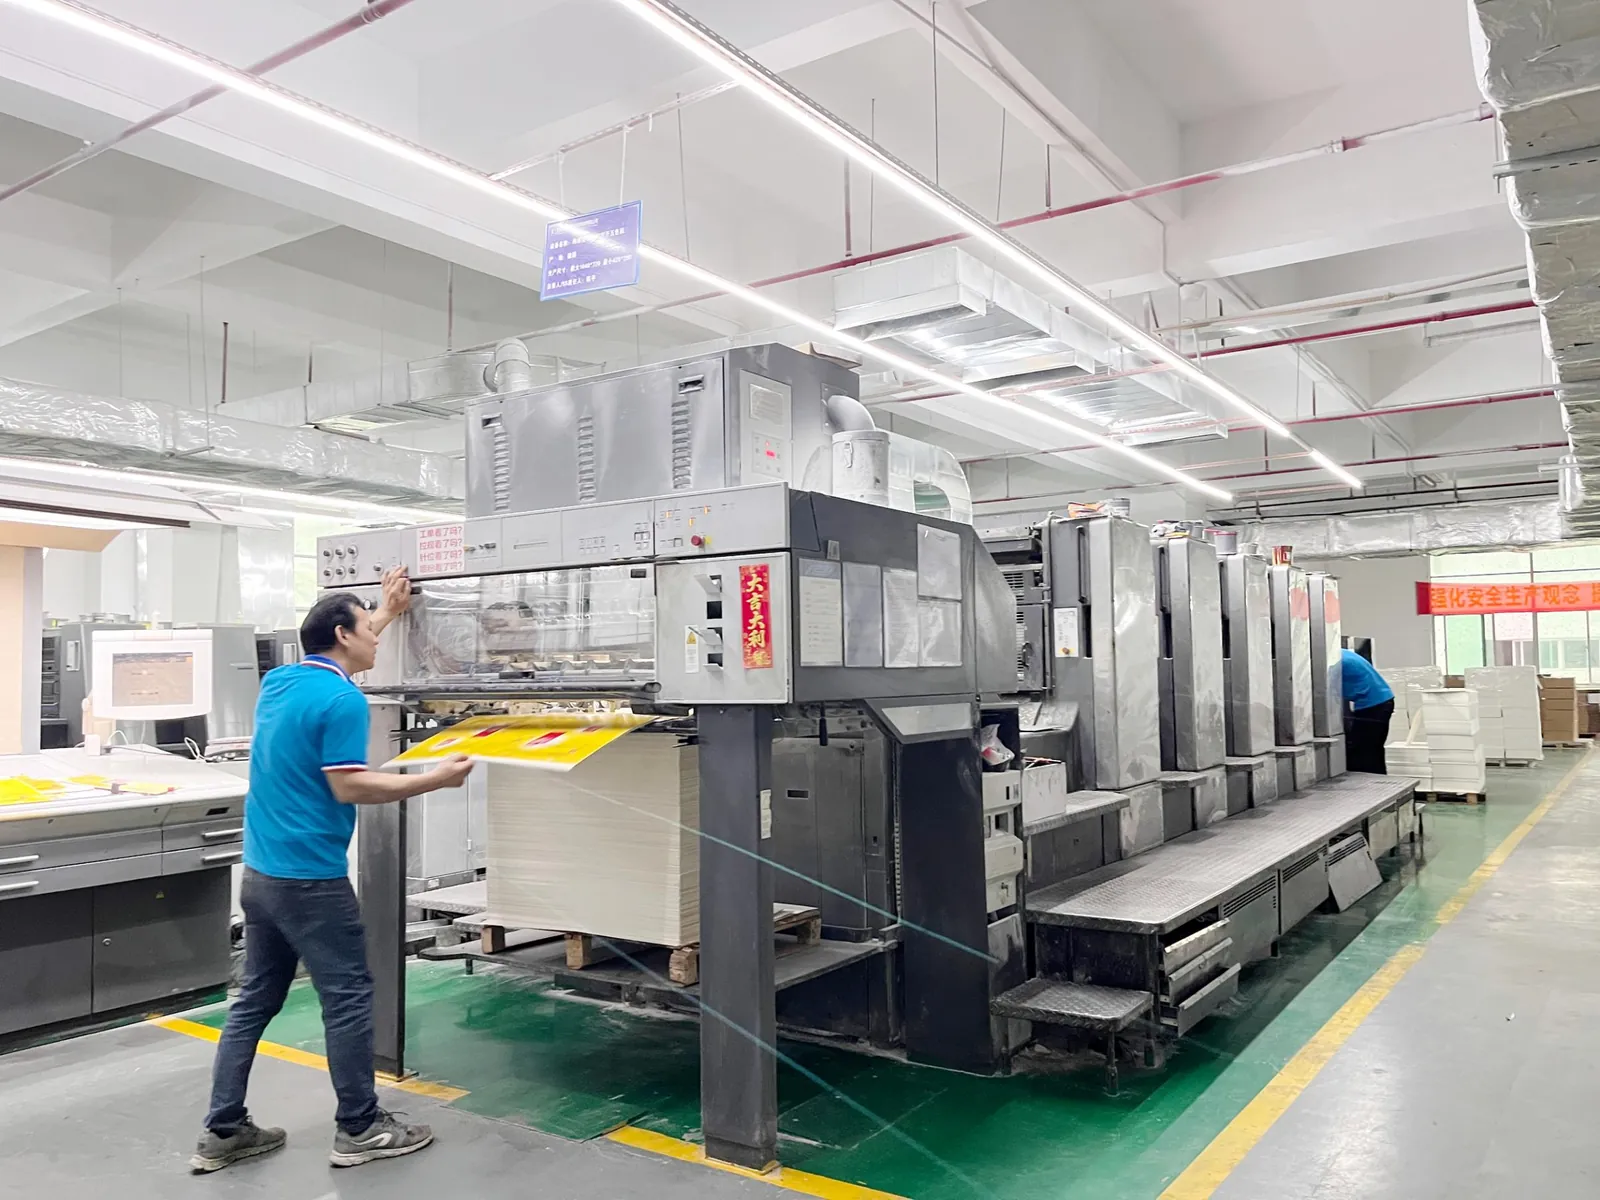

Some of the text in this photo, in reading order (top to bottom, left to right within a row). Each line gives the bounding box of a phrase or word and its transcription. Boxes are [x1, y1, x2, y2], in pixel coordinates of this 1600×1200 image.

[745, 573, 766, 648] 大吉大利
[1431, 584, 1580, 609] 强化安全生产观念
